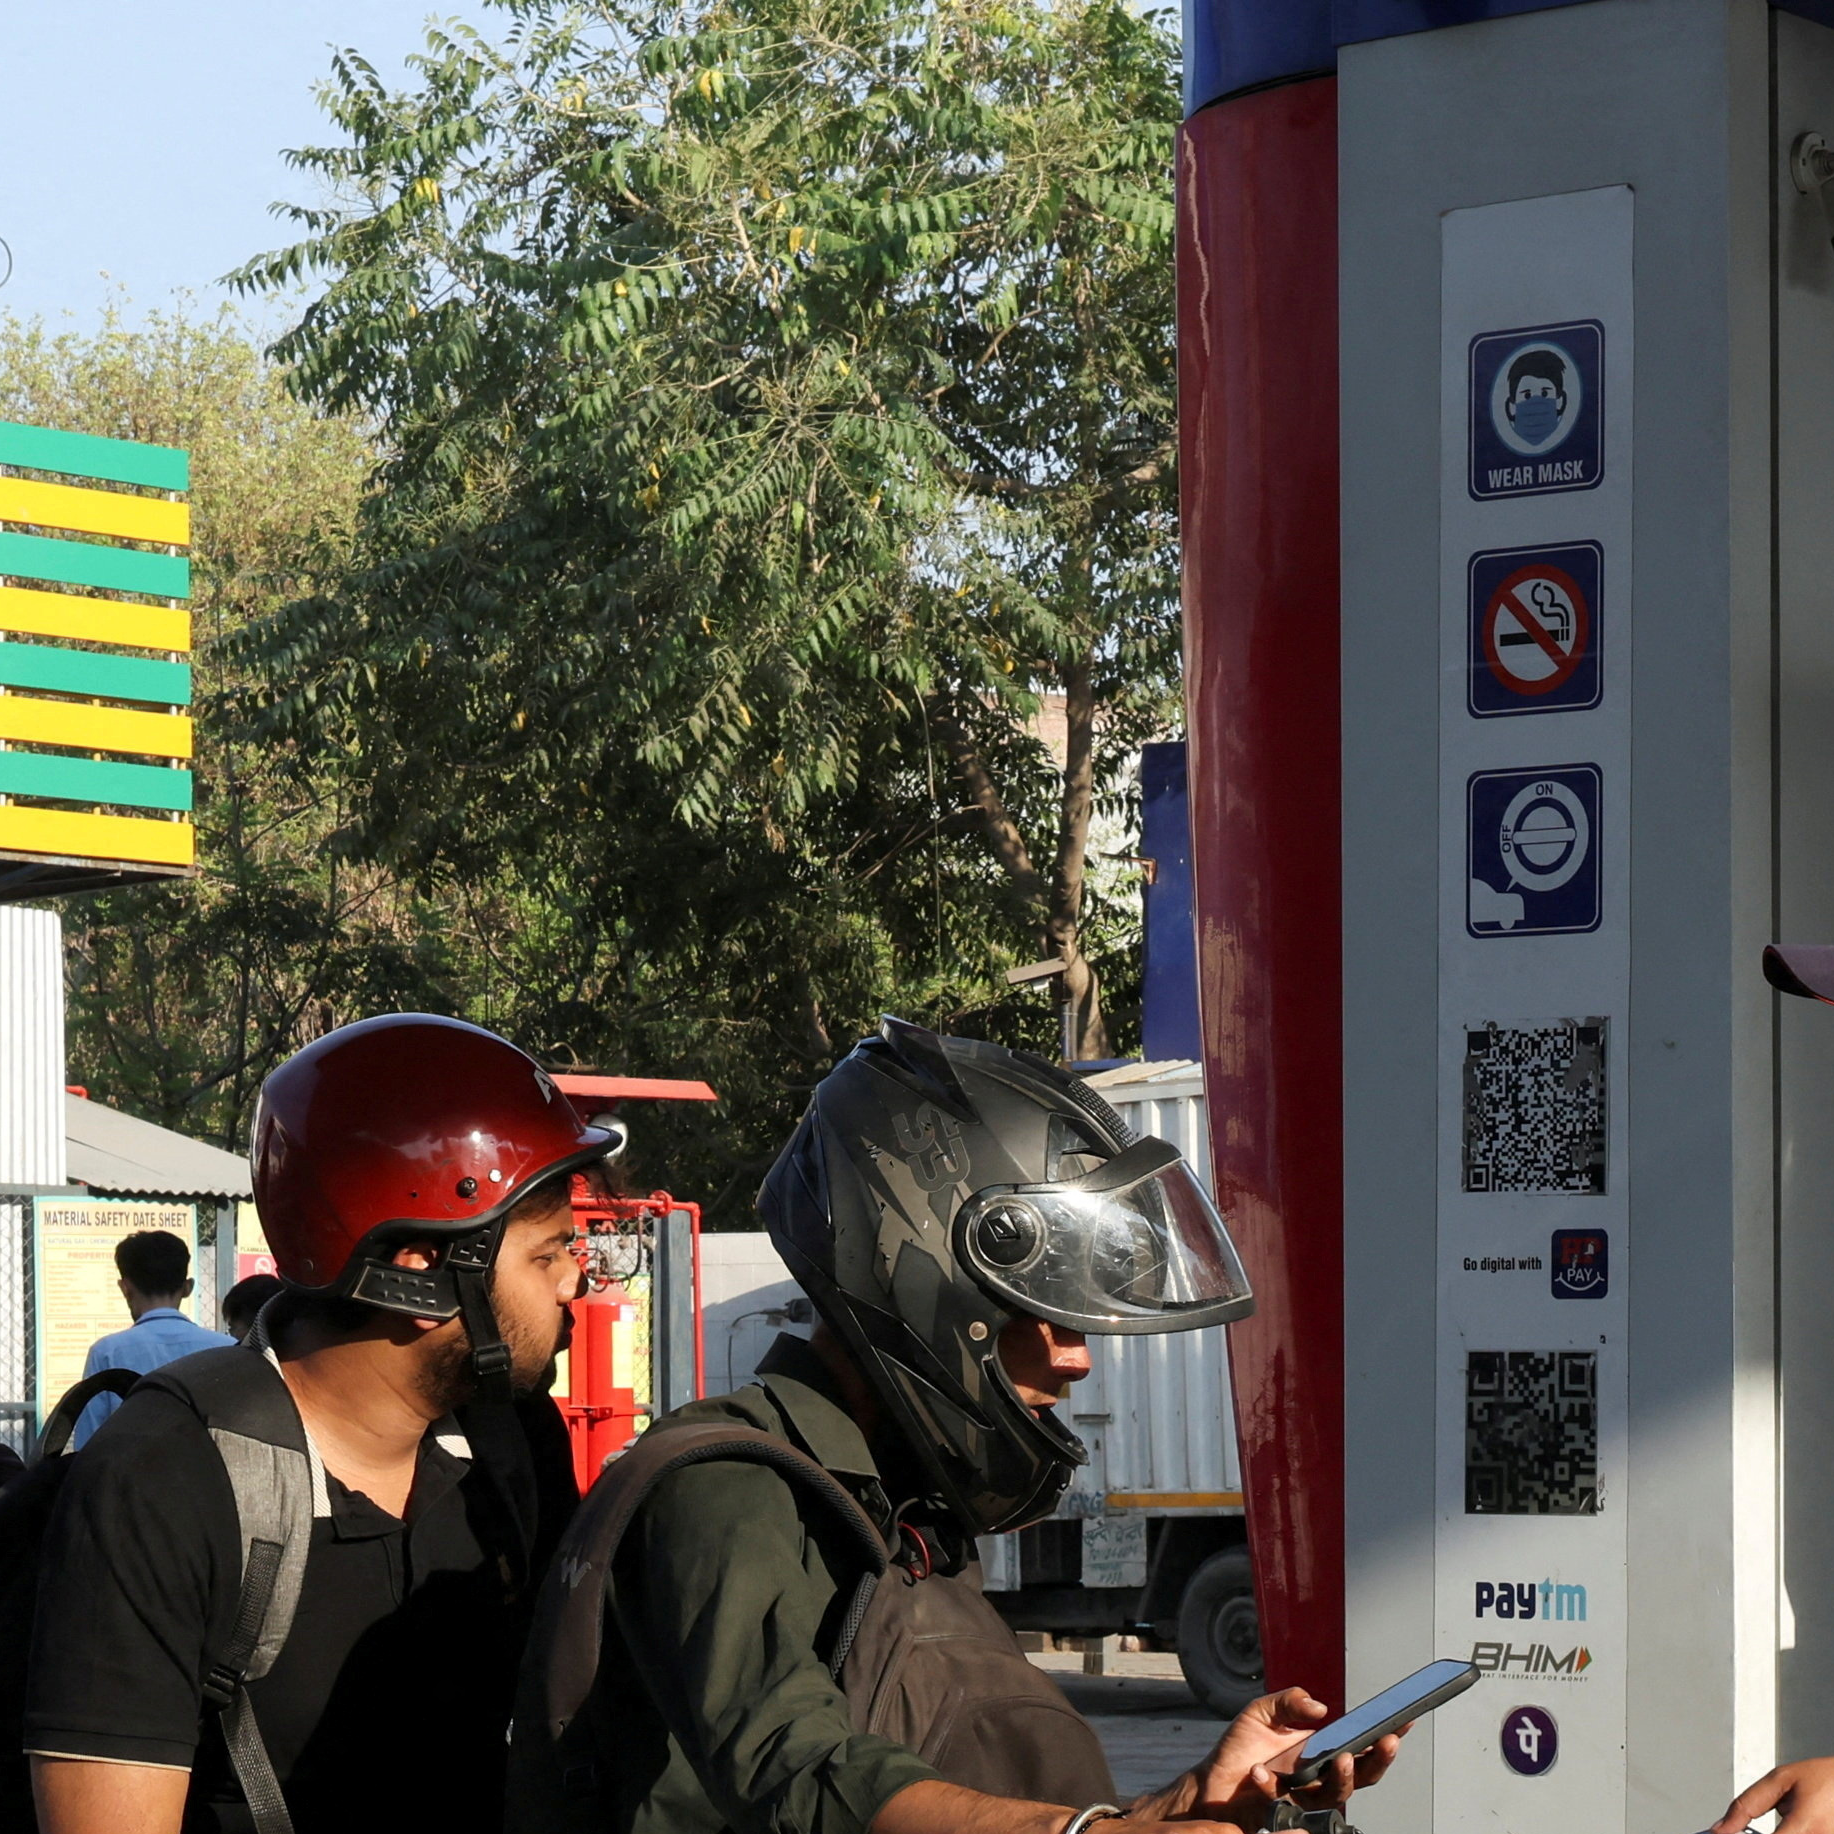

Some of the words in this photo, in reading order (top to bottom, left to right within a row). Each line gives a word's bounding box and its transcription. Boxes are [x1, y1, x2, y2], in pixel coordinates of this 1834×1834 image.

[1488, 463, 1533, 489] WEAR
[1538, 460, 1584, 484] MASK
[1535, 782, 1554, 797] ON
[1501, 824, 1512, 854] OFF
[44, 1211, 92, 1226] MATERIAL
[94, 1211, 130, 1227] SAFETY
[133, 1212, 156, 1228] DATE
[158, 1213, 188, 1228] SHEET
[68, 1252, 115, 1260] PROPERTIE
[1463, 1257, 1477, 1271] Go
[1481, 1257, 1515, 1273] digital
[1518, 1257, 1542, 1270] with
[1567, 1267, 1593, 1282] PAY
[1470, 1642, 1579, 1674] BHIM
[1516, 1716, 1542, 1762] पे
